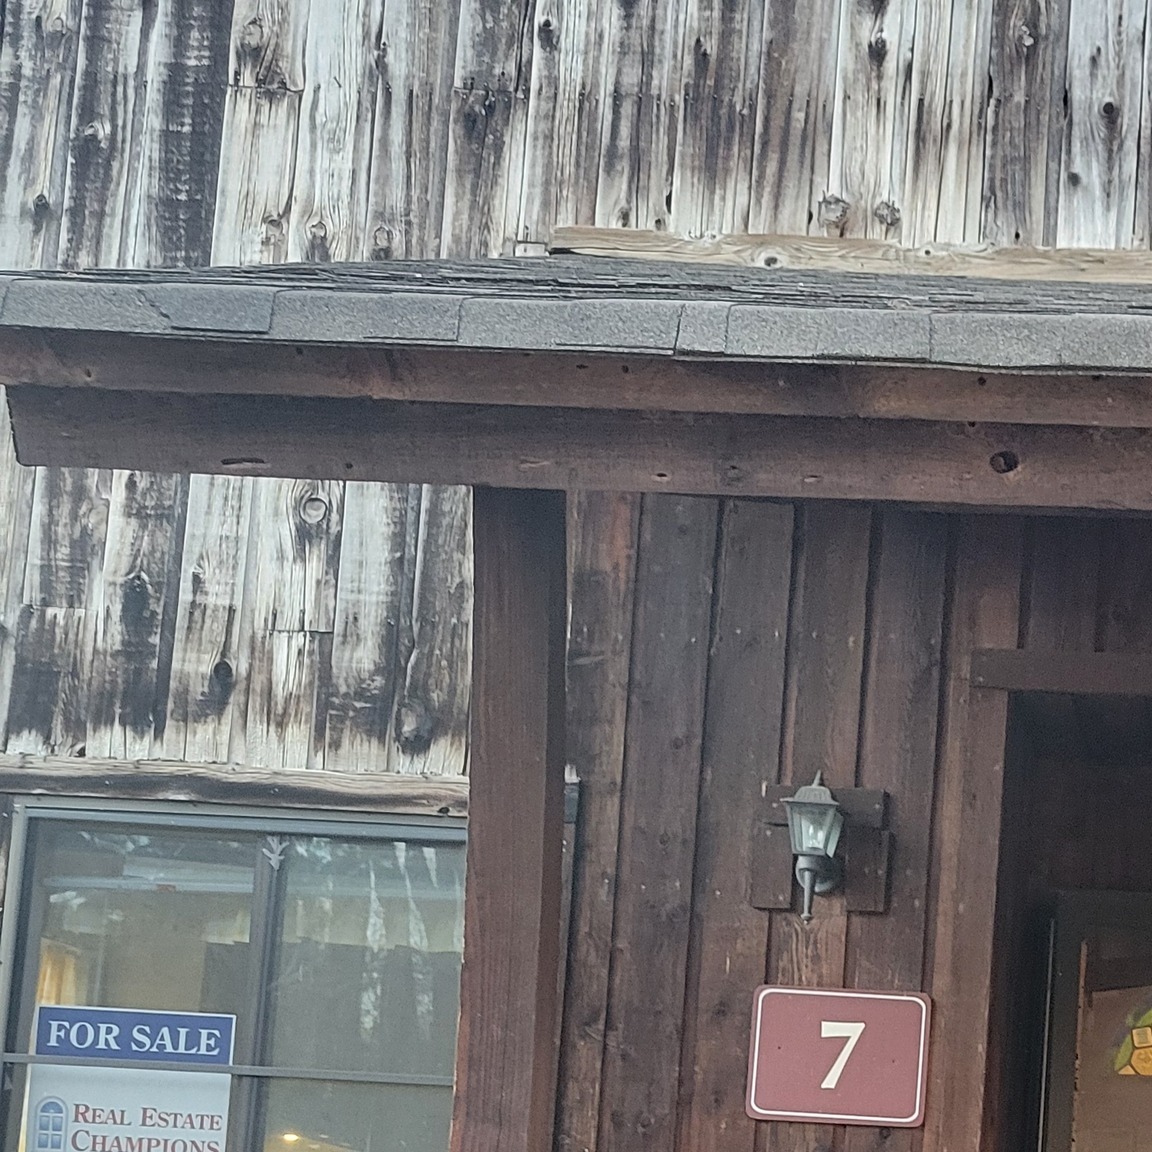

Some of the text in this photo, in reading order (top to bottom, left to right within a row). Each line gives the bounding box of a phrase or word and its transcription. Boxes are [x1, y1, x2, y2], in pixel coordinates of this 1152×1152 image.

[46, 1020, 221, 1056] FOR SALE
[820, 1020, 866, 1090] 7
